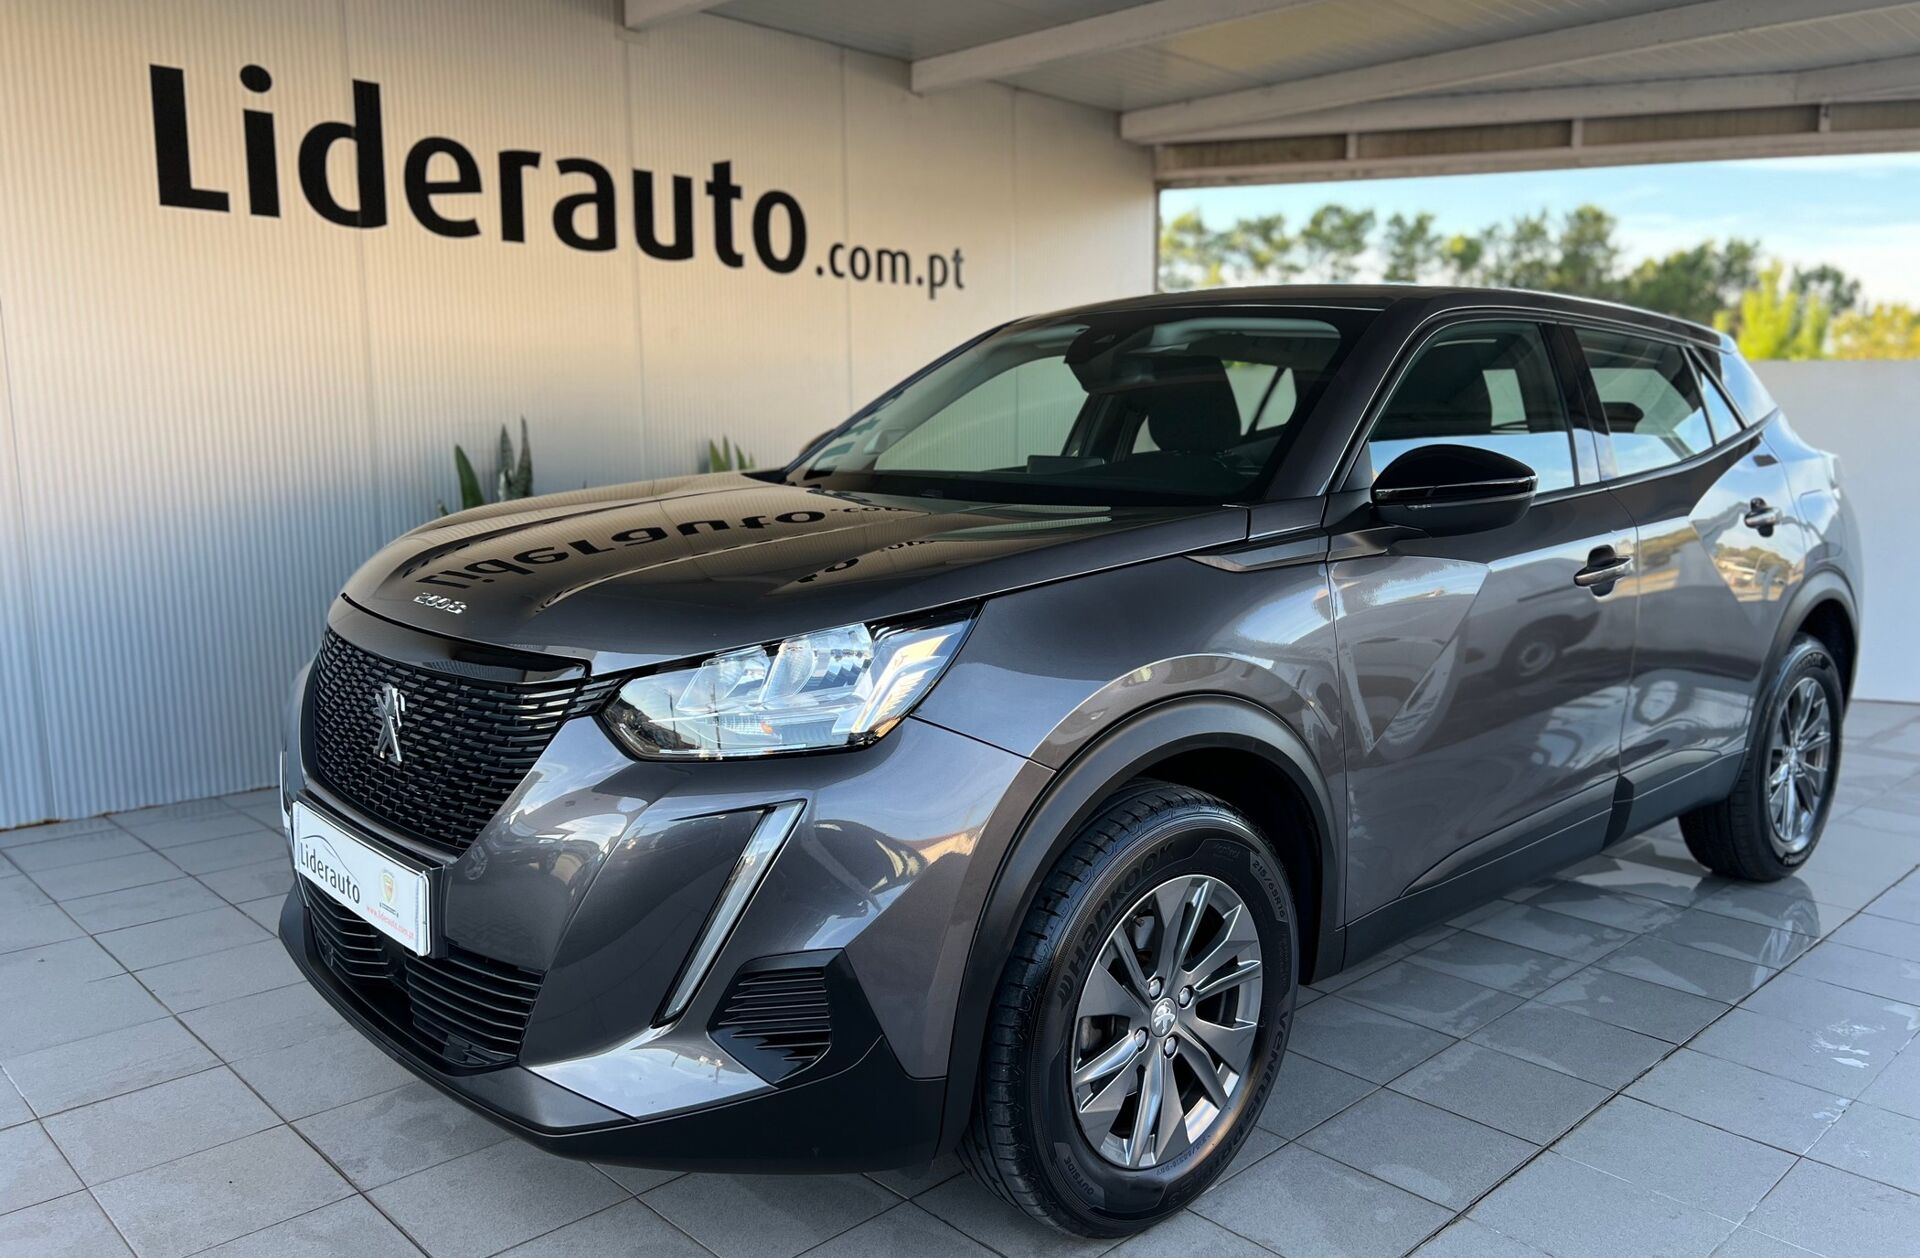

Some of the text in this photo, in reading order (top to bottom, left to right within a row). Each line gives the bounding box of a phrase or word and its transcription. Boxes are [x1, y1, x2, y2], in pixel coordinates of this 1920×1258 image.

[413, 592, 468, 615] 2008
[300, 842, 361, 905] Liderauto
[1063, 1156, 1095, 1195] OUTSIDE
